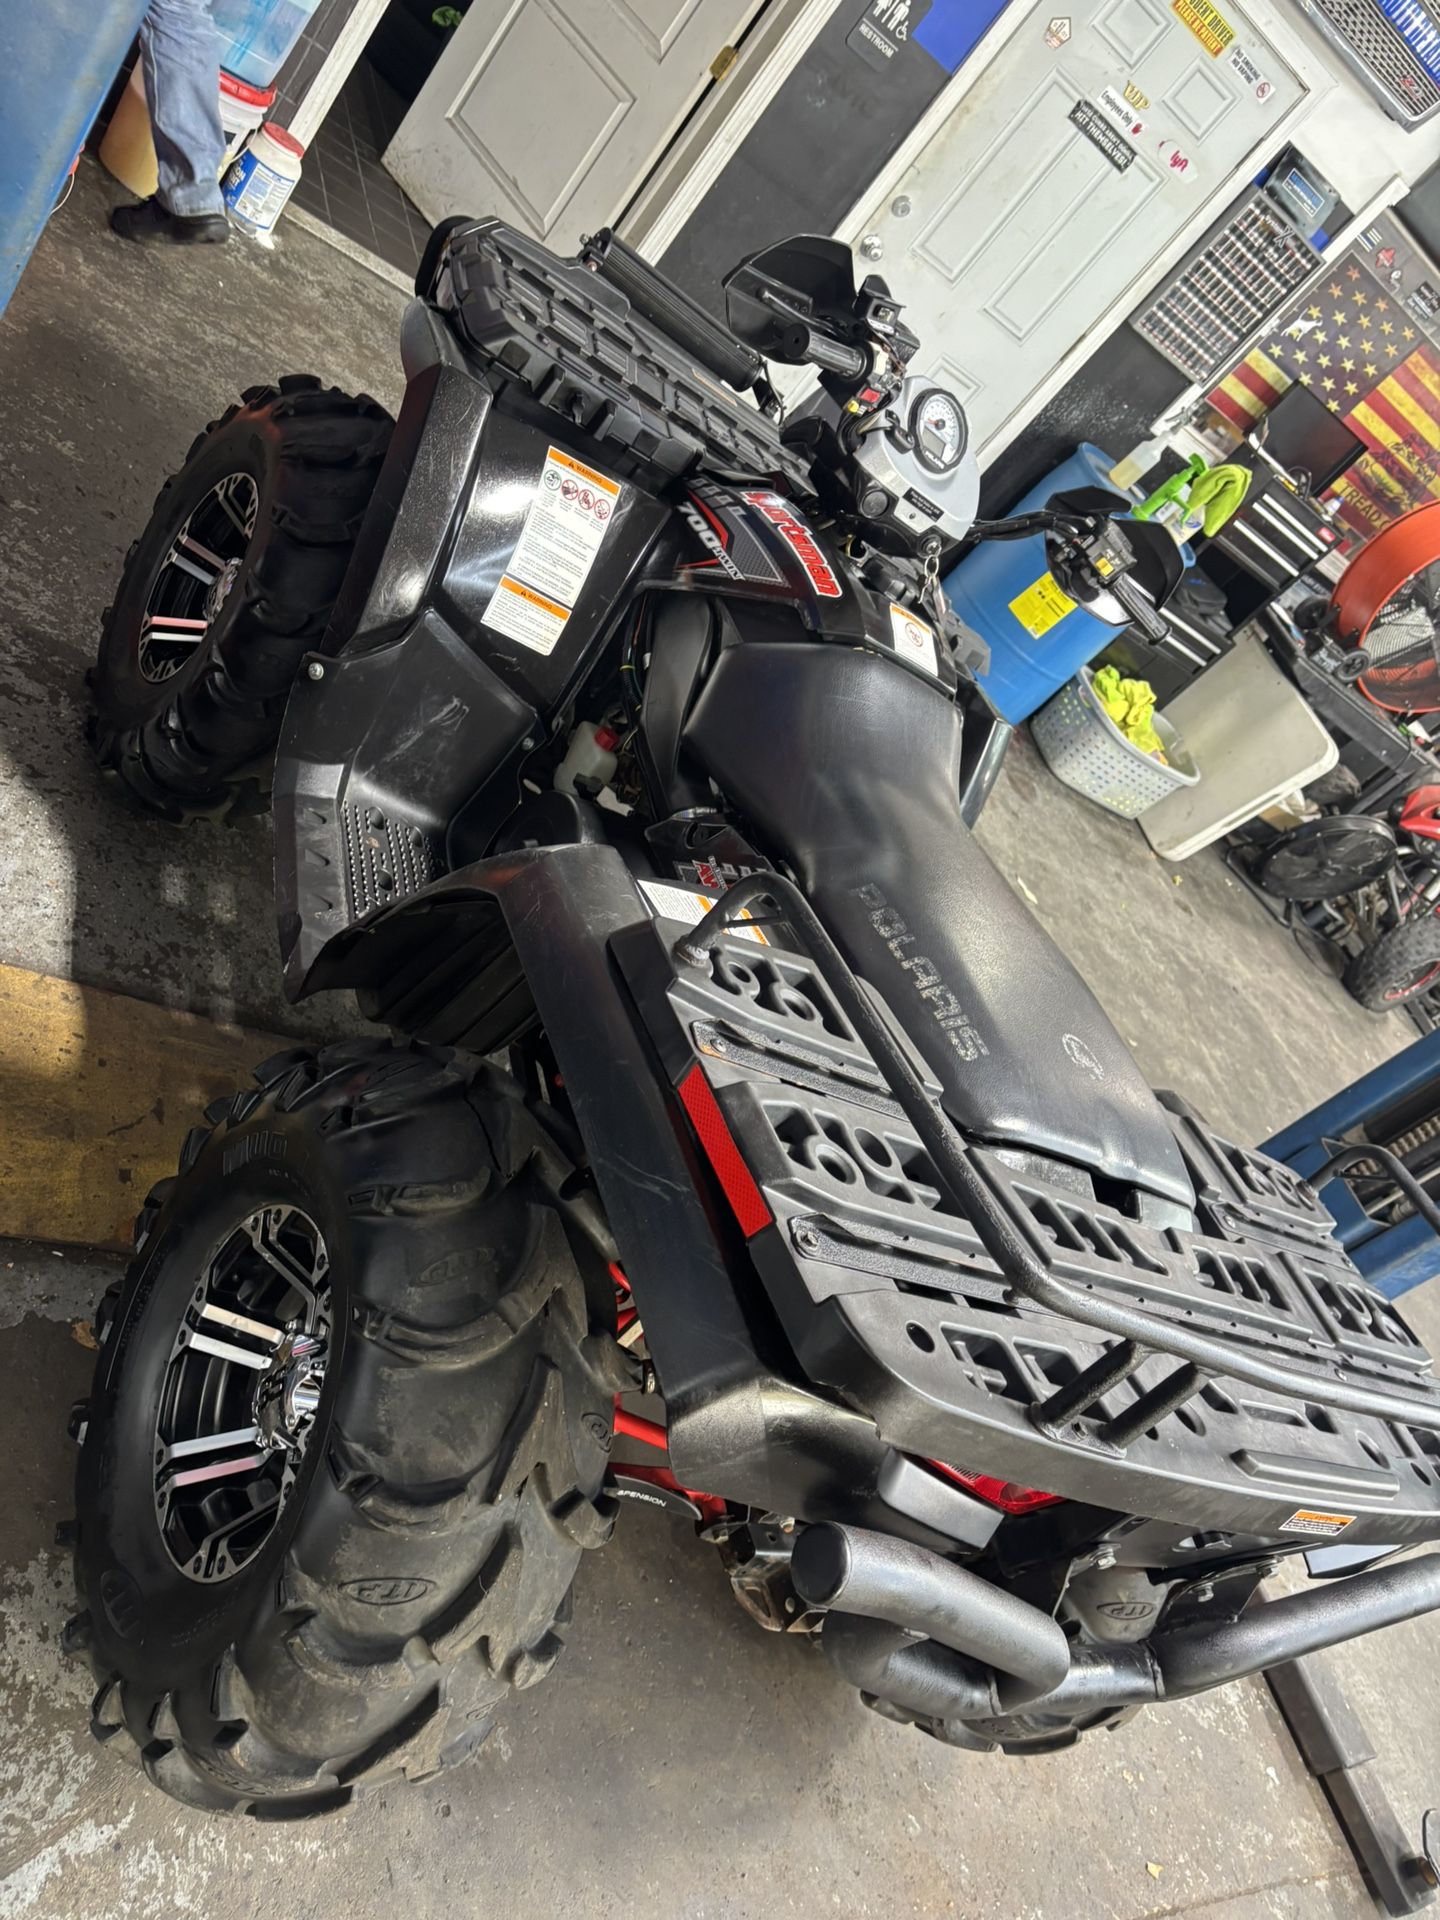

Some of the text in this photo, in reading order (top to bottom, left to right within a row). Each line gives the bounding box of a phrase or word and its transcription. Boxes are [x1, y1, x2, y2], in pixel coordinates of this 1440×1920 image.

[859, 23, 894, 58] RESTROOM
[1207, 15, 1234, 46] DRIVER
[1231, 57, 1254, 84] NO VAPING
[1235, 48, 1261, 81] NO SMOKING
[1100, 90, 1134, 128] Employees Only
[1073, 109, 1128, 168] HIT THEMSELVES!
[1170, 150, 1188, 172] lyft
[575, 463, 604, 484] WARNING
[1339, 483, 1381, 523] TREAD
[676, 501, 746, 581] 700 TWIN
[740, 491, 843, 598] Sportsman
[527, 589, 553, 610] WARNING
[850, 882, 990, 1061] POLARIS
[358, 1582, 416, 1600] ITP
[1110, 1604, 1146, 1616] ITP
